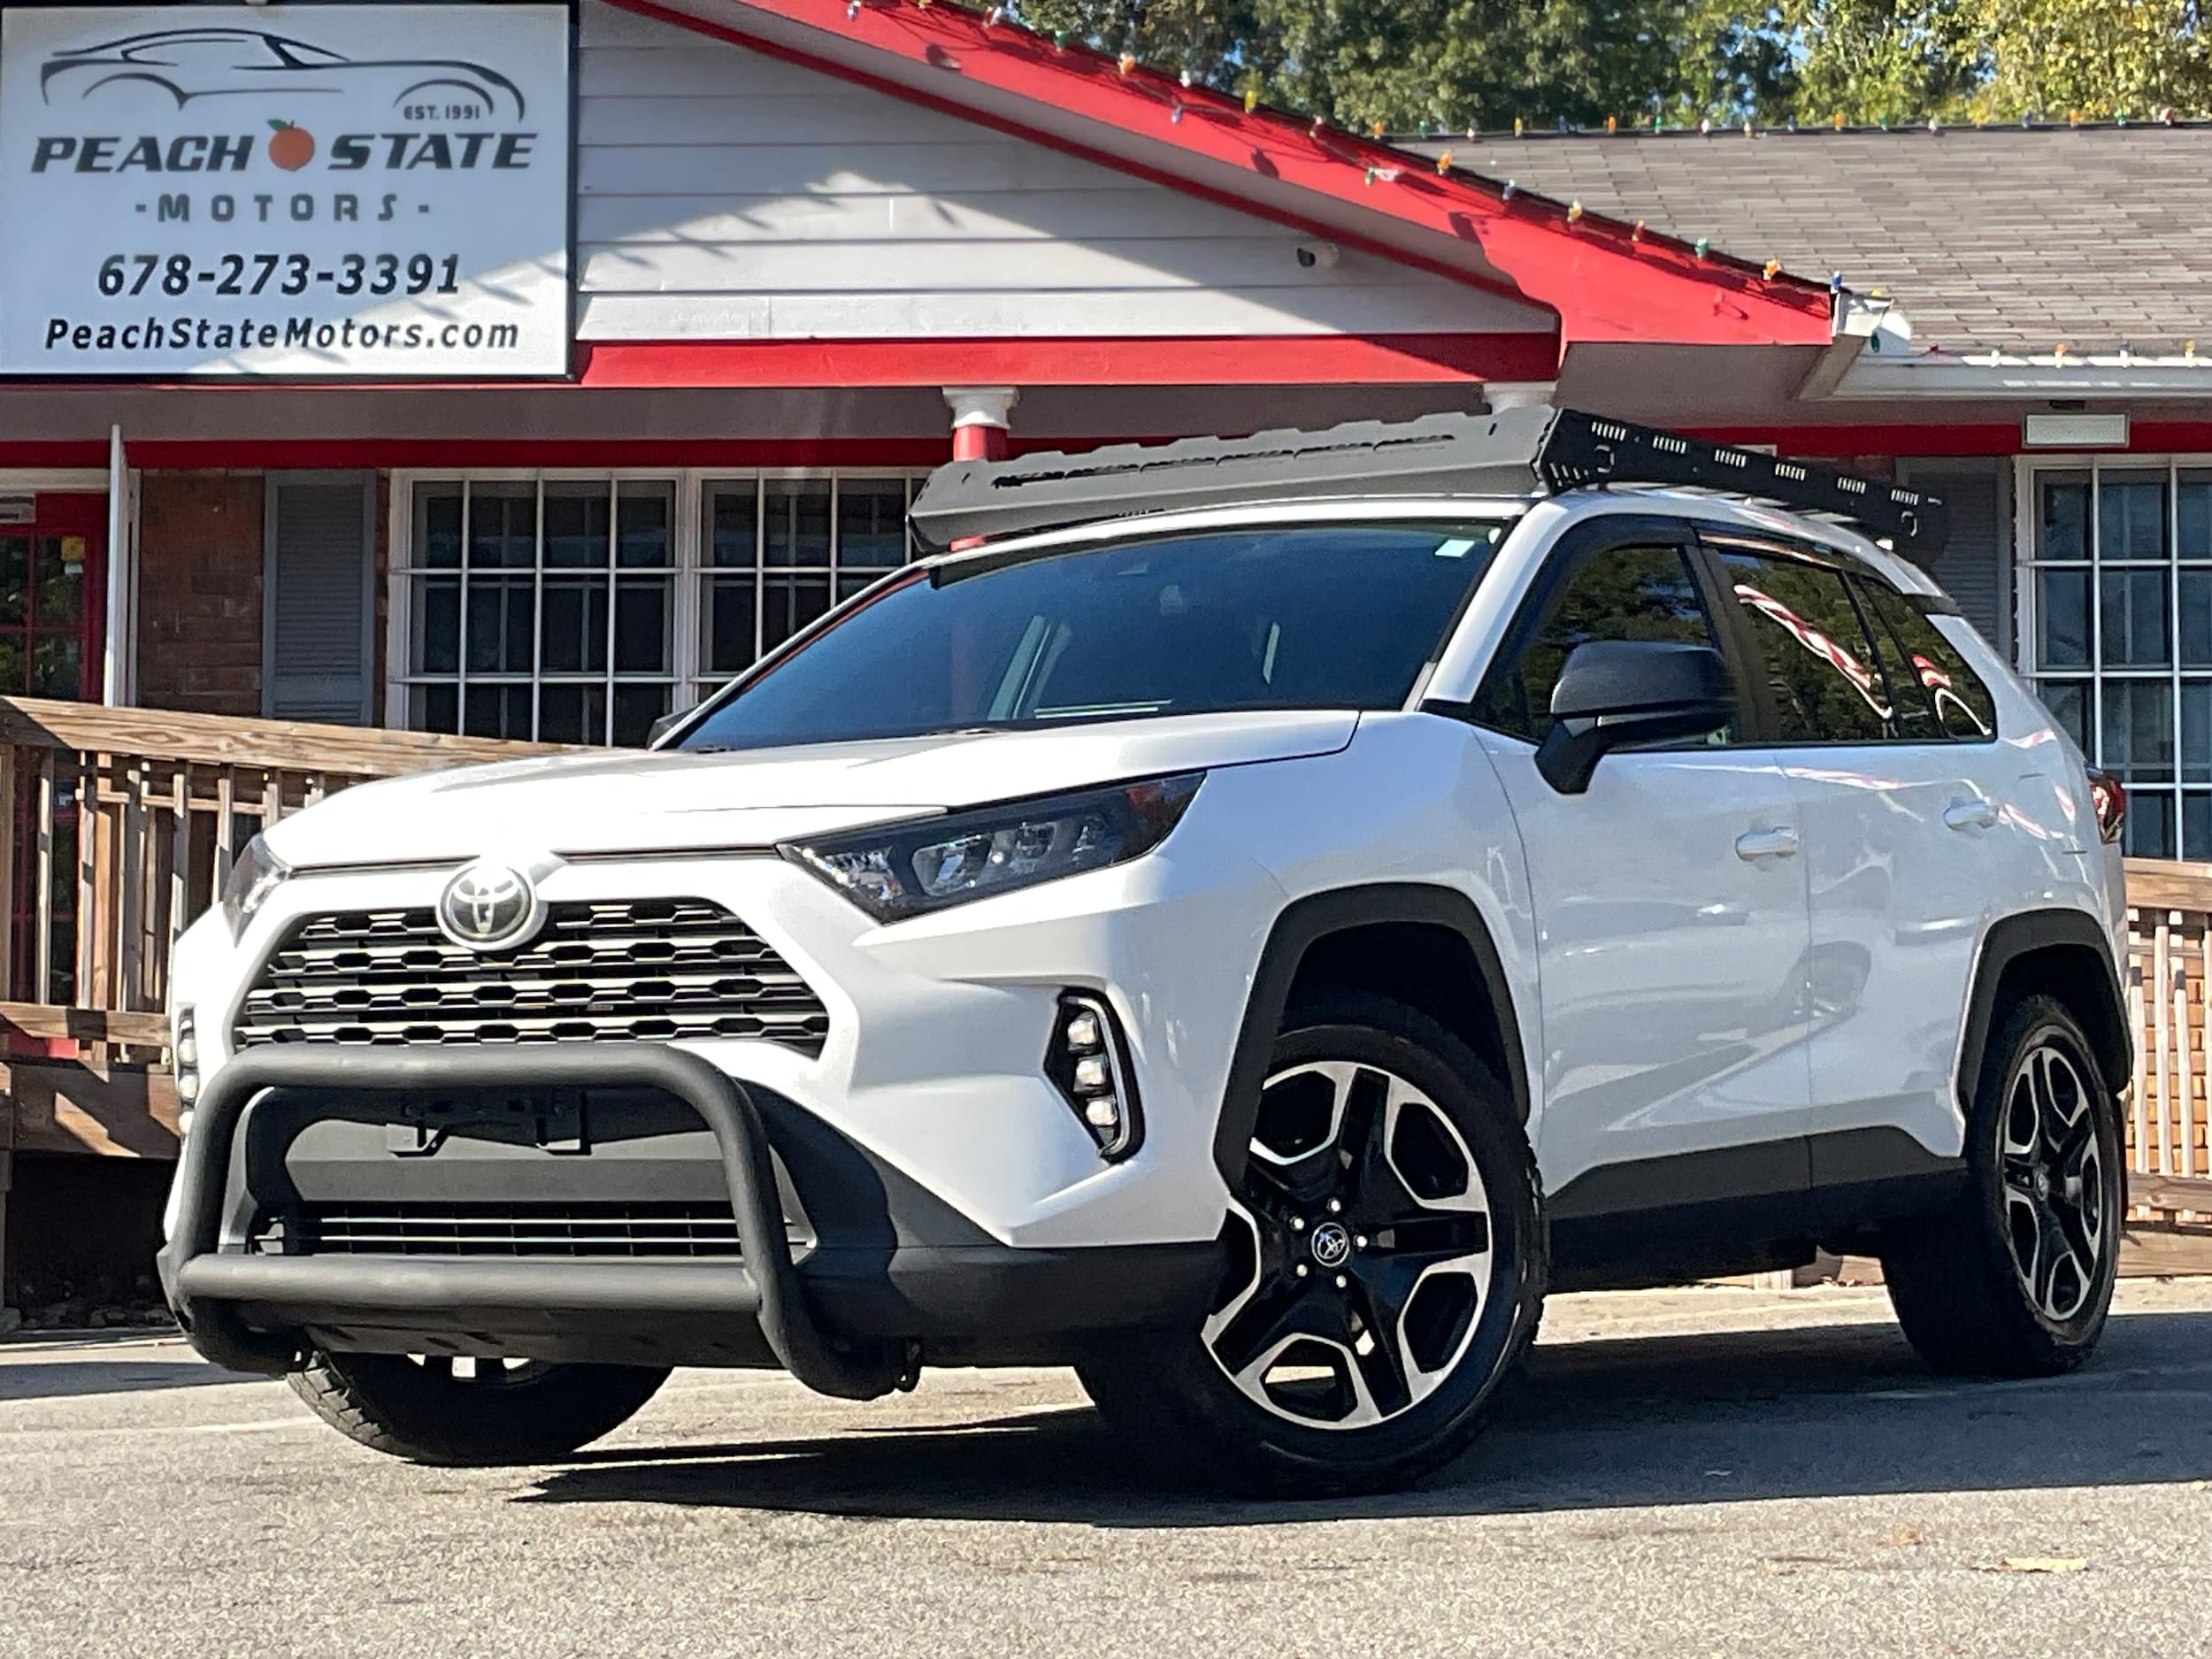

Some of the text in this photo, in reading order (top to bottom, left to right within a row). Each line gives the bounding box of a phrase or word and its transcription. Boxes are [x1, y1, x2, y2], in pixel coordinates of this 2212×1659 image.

[403, 104, 480, 120] EST. 1991
[31, 133, 538, 173] PEACH STATE
[97, 253, 459, 296] 678-273-3391
[46, 317, 518, 349] PeachStateMotors.com
